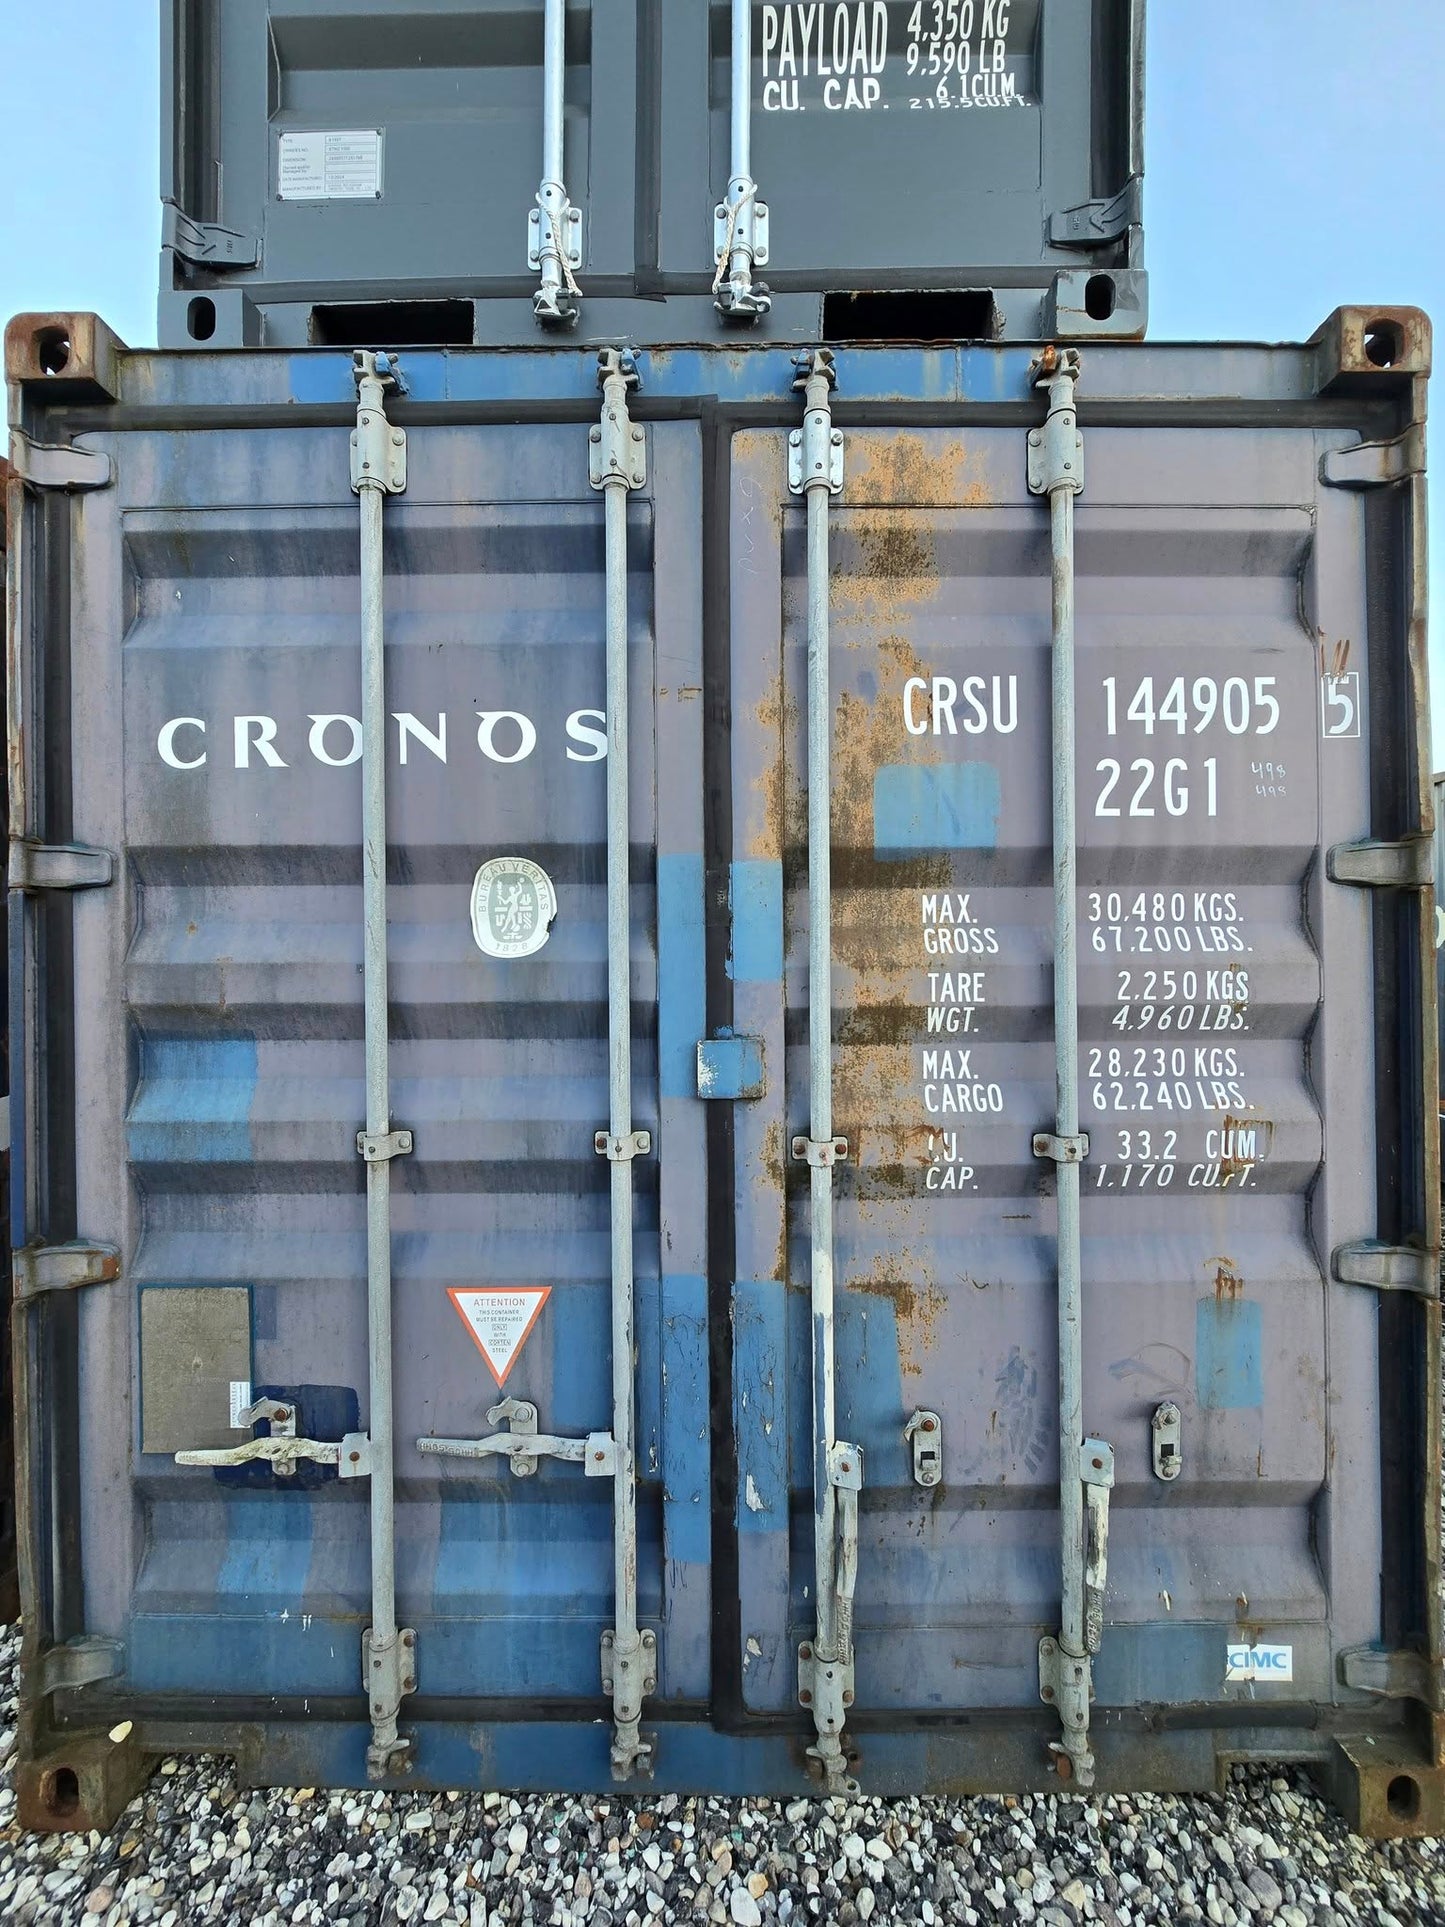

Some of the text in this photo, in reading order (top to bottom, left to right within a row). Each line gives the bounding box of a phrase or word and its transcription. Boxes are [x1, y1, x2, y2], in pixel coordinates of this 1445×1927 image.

[907, 0, 1010, 42] 4,350 KG
[763, 2, 888, 77] PAYLOAD
[907, 39, 1006, 76] 9,590 LB
[763, 78, 889, 111] CU. CAP.
[903, 675, 1354, 736] CRSU 144905 5
[157, 709, 608, 769] CRONOS
[1095, 757, 1217, 817] 22G1
[479, 863, 548, 912] BUREAU VERITAS
[922, 894, 978, 924] MAX.
[1088, 893, 1243, 922] 30,480 KGS.
[495, 942, 528, 951] 1828
[924, 928, 999, 954] GROSS
[1092, 926, 1253, 952] 67,200 LBS.
[928, 973, 985, 1002] TARE
[1117, 971, 1197, 1000] 2,250
[927, 1007, 979, 1033] WGT.
[1112, 1004, 1250, 1030] 4,960 LBS.
[922, 1050, 979, 1079] MAX.
[1088, 1048, 1245, 1077] 28,230 KGS.
[924, 1083, 1004, 1113] CARGO
[1092, 1081, 1255, 1110] 62,240 LBS.
[1118, 1130, 1177, 1160] 33.2
[926, 1166, 978, 1189] CAP.
[1096, 1164, 1174, 1187] 1,170
[474, 1298, 525, 1306] ATTENTION
[1229, 1651, 1287, 1668] CIMC
